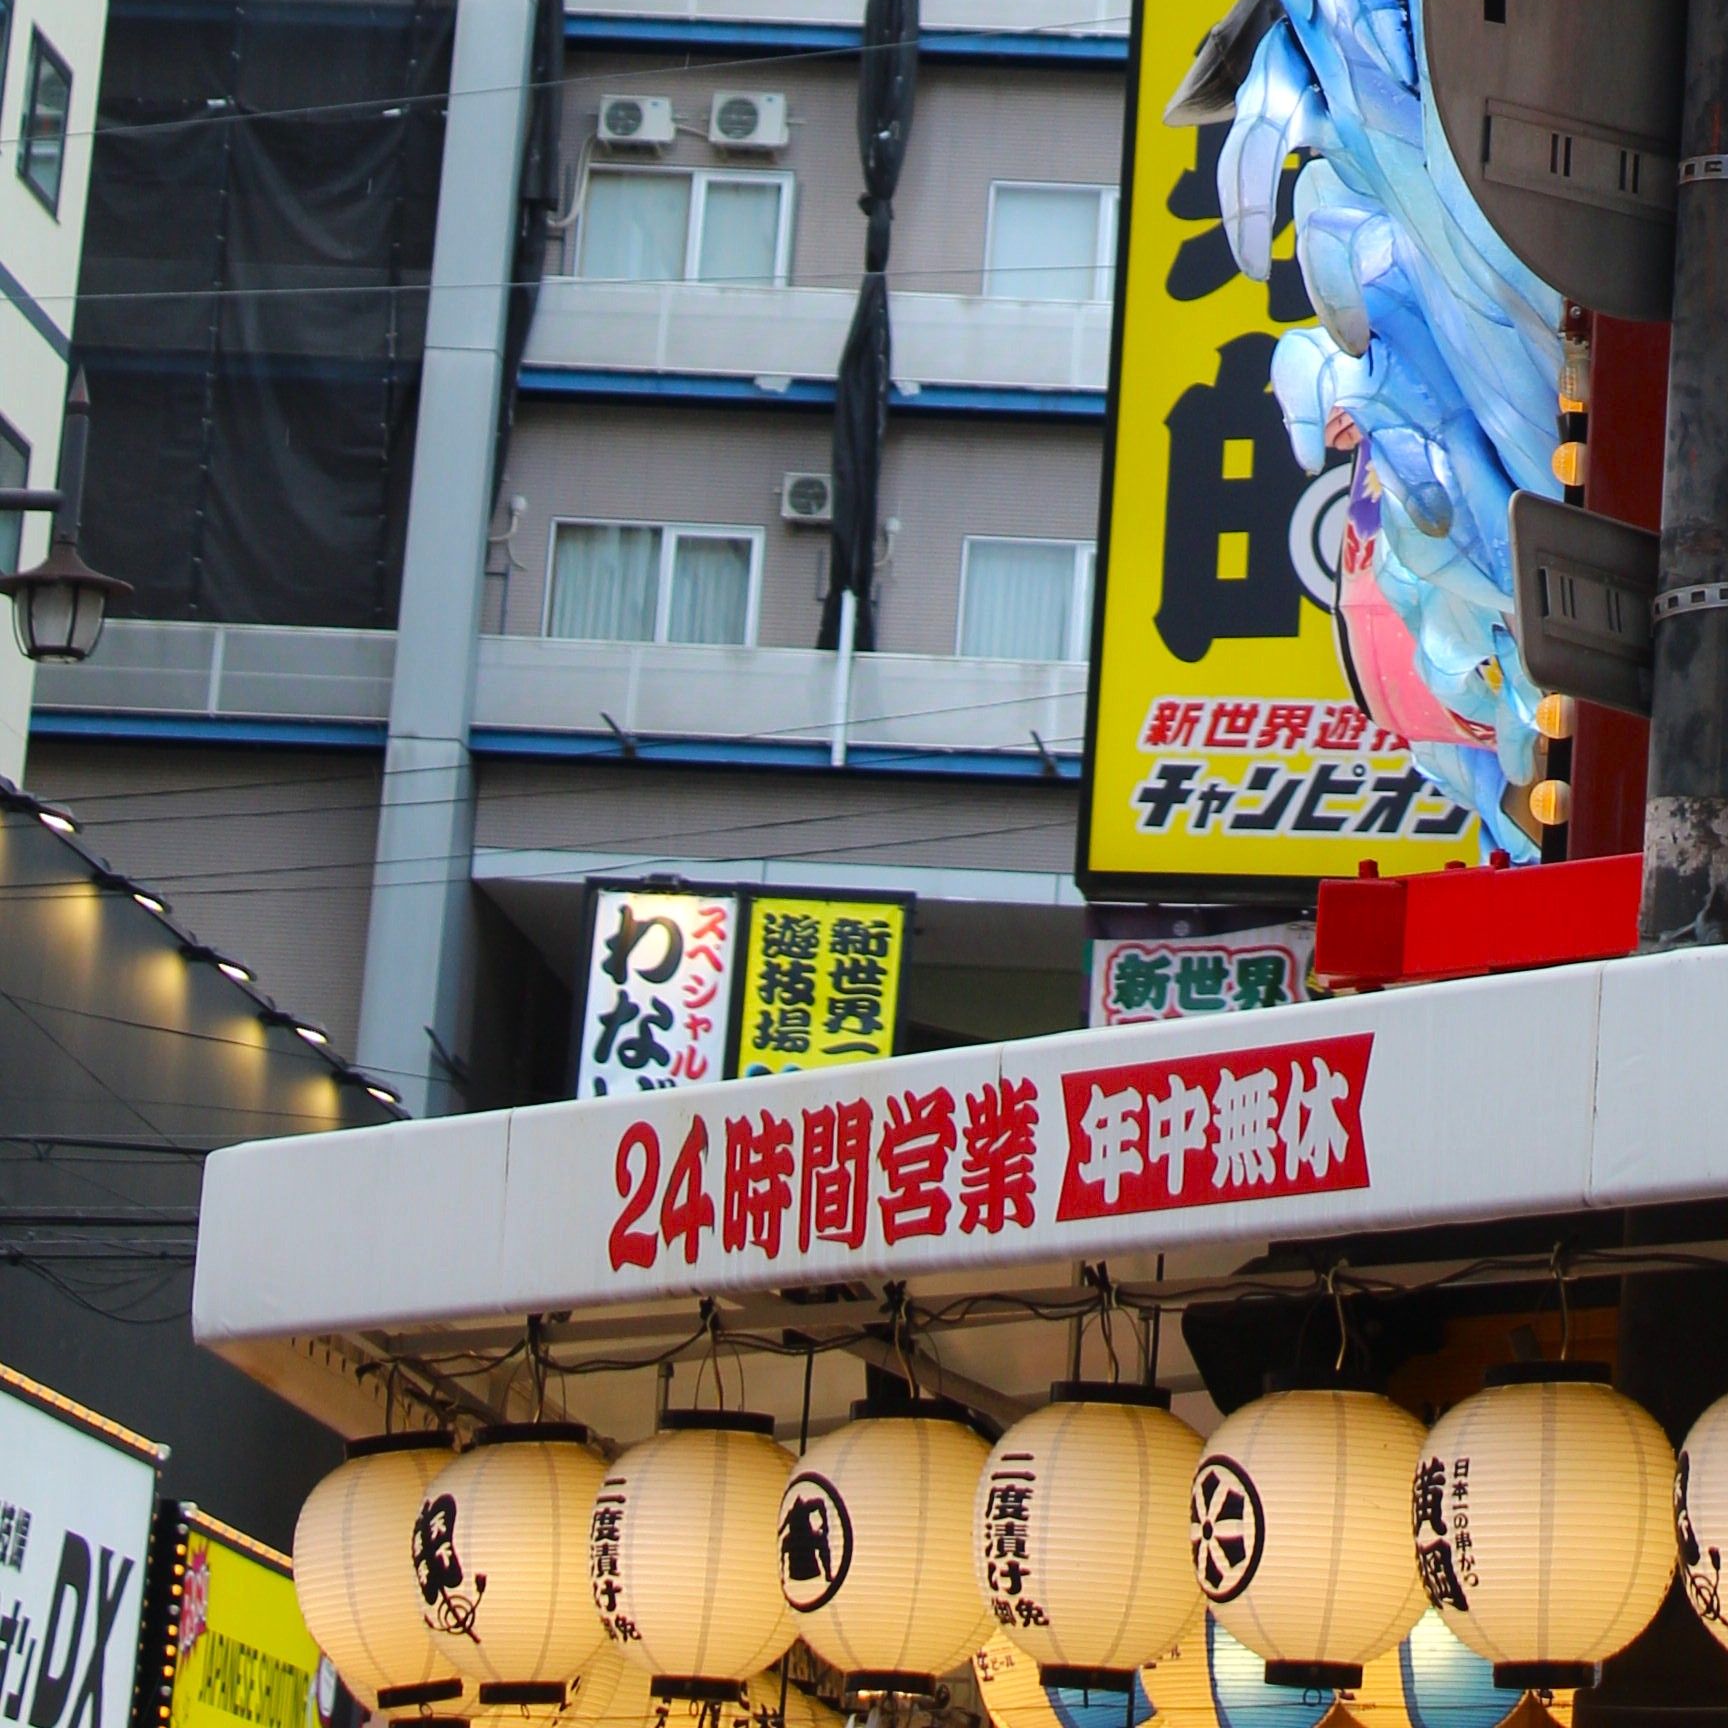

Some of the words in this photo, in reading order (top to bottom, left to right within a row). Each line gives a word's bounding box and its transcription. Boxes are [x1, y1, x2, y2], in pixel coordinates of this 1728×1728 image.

[670, 905, 728, 1080] スペシャル
[752, 911, 822, 1054] 遊技場
[1110, 950, 1292, 1012] 新世界
[607, 1074, 1039, 1273] 24時間営業
[1080, 1055, 1351, 1205] 年中無休
[984, 1452, 1037, 1595] 二度漬け
[1451, 1456, 1479, 1588] 日本一の串かつ
